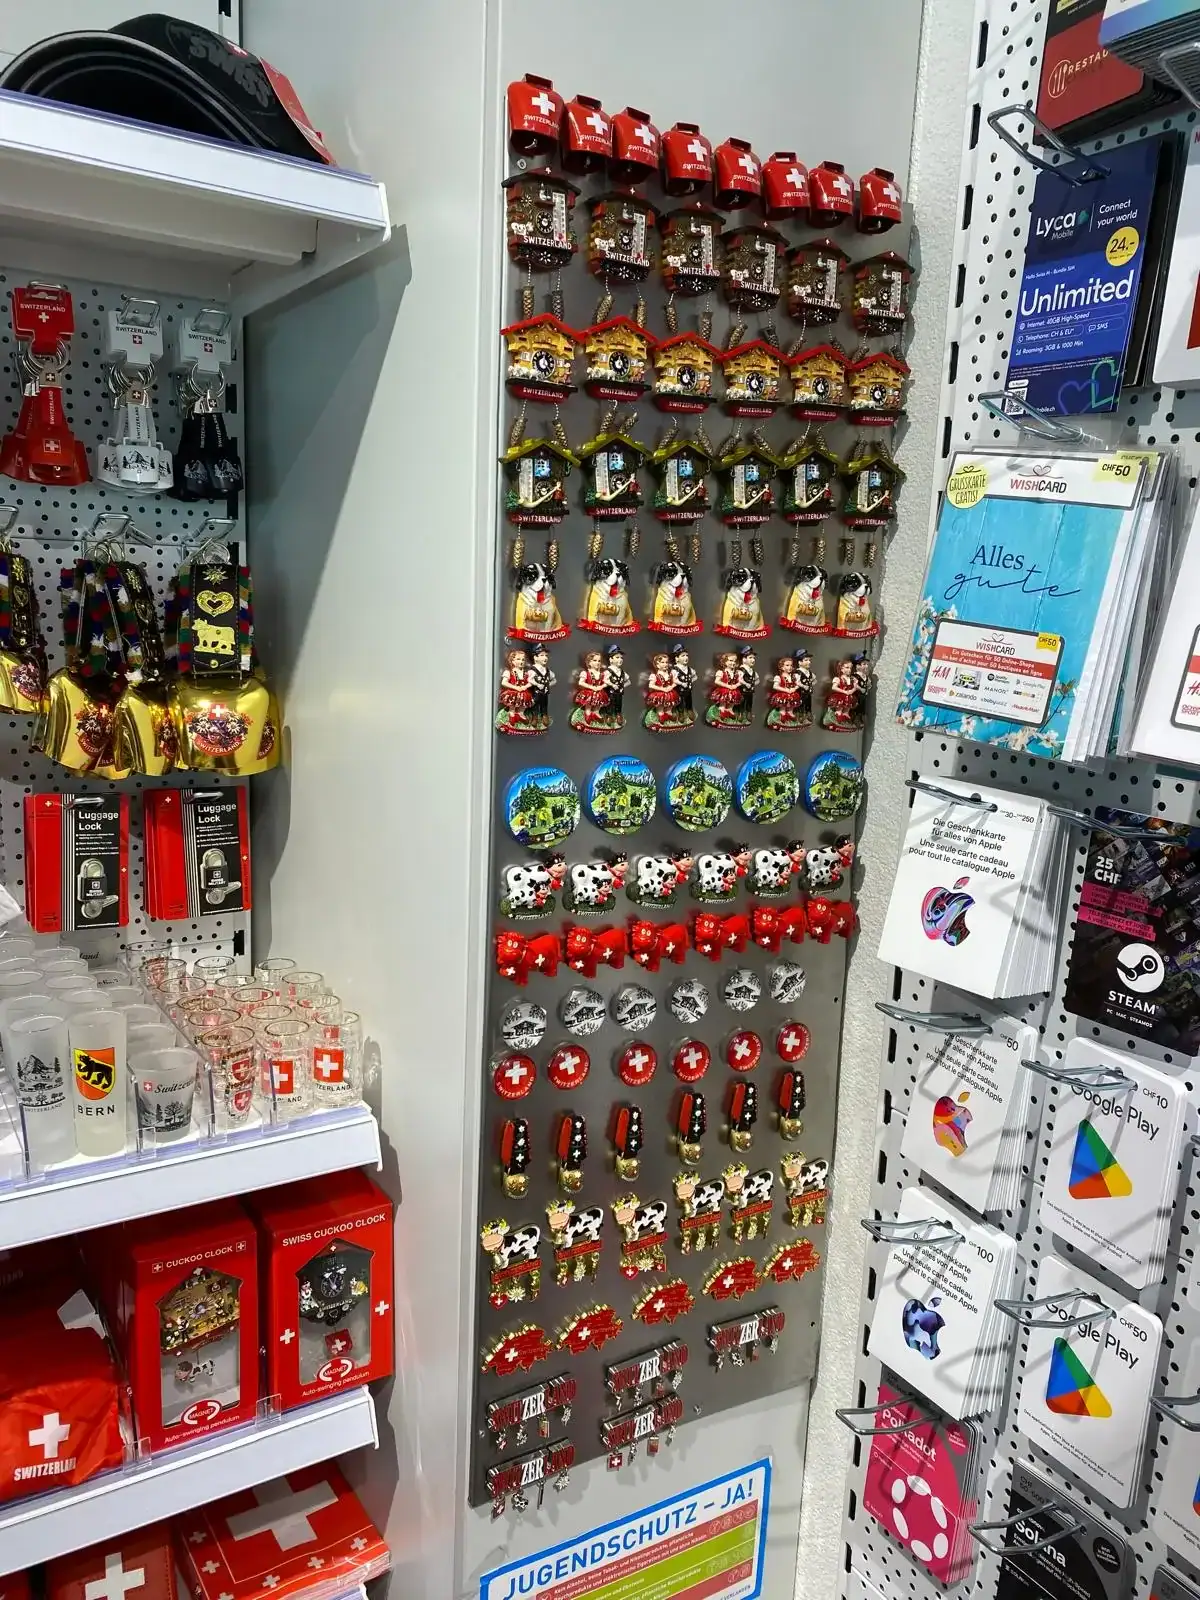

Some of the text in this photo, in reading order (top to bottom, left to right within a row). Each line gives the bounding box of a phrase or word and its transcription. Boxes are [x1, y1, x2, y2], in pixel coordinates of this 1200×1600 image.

[1099, 199, 1132, 214] Connect
[1035, 211, 1077, 237] Lyca
[1097, 209, 1139, 229] your world
[523, 235, 572, 250] SWITZERLAND
[1052, 229, 1074, 240] Mobile
[1109, 237, 1135, 254] 24.-
[605, 250, 650, 267] SWITZERLAND
[678, 266, 720, 278] SWITZERLAND
[740, 281, 780, 295] SWITZERLAND
[1020, 270, 1135, 317] Unlimited
[20, 302, 66, 313] SWITZERLAND
[803, 296, 842, 310] SWITZERLAND
[868, 308, 906, 320] SWITZERLAND
[1061, 312, 1091, 323] High-Speed
[115, 326, 158, 336] SWITZERLAND
[1096, 322, 1109, 330] SMS
[188, 334, 226, 345] SWITZERLAND
[1061, 341, 1074, 349] 1000
[523, 387, 564, 399] SWITZERLAND
[949, 474, 986, 491] GRUSSKARTE
[1010, 478, 1068, 494] WISHCARD
[955, 489, 979, 505] GRATIS!
[518, 514, 562, 524] SWITZERLAND
[596, 507, 637, 515] SWITZERLAND
[667, 512, 704, 520] SWITZERLAND
[795, 512, 830, 520] SWITZERLAND
[855, 518, 887, 526] SWITZERLAND
[969, 544, 1025, 570] Alles
[944, 564, 1081, 600] gute
[524, 630, 566, 641] SWITZERLAND
[594, 624, 636, 635] SWITZERLAND
[661, 625, 700, 635] SWITZERLAND
[729, 628, 767, 639] SWITZERLAND
[794, 622, 829, 634] SWITZERLAND
[846, 627, 877, 639] SWITZERLAND
[975, 641, 1016, 656] WISHCARD
[960, 650, 984, 659] Gutschein
[1001, 657, 1035, 669] Online-Shops
[932, 666, 952, 680] H&M
[998, 663, 1022, 673] boutiques
[1030, 668, 1043, 677] ligne
[956, 692, 978, 701] zalando
[984, 686, 1007, 694] MANOR
[78, 810, 119, 821] Luggage
[197, 803, 237, 813] Luggage
[78, 822, 102, 831] Lock
[198, 814, 221, 824] Lock
[932, 817, 1006, 842] Die Geschenkkarte
[931, 827, 1002, 852] für alles von Apple
[919, 838, 1009, 868] Une seule carte cadeau
[908, 846, 1016, 880] pour tout le catalogue Apple
[1095, 856, 1114, 870] 25
[1094, 868, 1121, 885] CHF
[1108, 990, 1156, 1015] STEAM
[1116, 1011, 1127, 1019] MAC
[1129, 1016, 1153, 1028] STEAMOS
[954, 1034, 998, 1065] Geschenkkarte
[952, 1044, 995, 1074] alles von Apple
[553, 1061, 589, 1088] SWITZERLAND
[621, 1061, 656, 1086] SWITZERLAND
[934, 1046, 999, 1091] Une seule carte cadeau
[496, 1075, 535, 1098] SWITZERLAND
[950, 1065, 957, 1075] le
[957, 1071, 985, 1094] catalogue
[984, 1088, 1003, 1104] Apple
[1142, 1088, 1168, 1109] CHF10
[25, 1103, 63, 1113] SWITZERLAND
[77, 1104, 115, 1116] BERN
[1071, 1085, 1160, 1141] Google Play
[282, 1213, 386, 1247] SWISS CUCKOO CLOCK
[166, 1245, 233, 1269] CUCKOO CLOCK
[902, 1248, 973, 1300] Une seule carte cadeau
[921, 1249, 968, 1283] alles von Apple
[893, 1253, 978, 1314] pour tout le catalogue Apple
[715, 1312, 786, 1351] SWITZERLAND
[1119, 1317, 1148, 1342] CHF50
[1104, 1334, 1139, 1370] Play
[323, 1365, 348, 1377] MAGNET
[613, 1345, 689, 1392] SWITZERLAND
[302, 1371, 370, 1397] Auto-swinging pendulum
[188, 1405, 215, 1420] MAGNET
[493, 1379, 576, 1431] SWITZERLAND
[164, 1414, 240, 1444] Auto-swinging pendulum
[608, 1401, 683, 1448] SWITZERLAND
[493, 1446, 575, 1497] SWITZERLAND
[502, 1502, 697, 1600] JUGENDSCHUTZ
[720, 1477, 754, 1509] JA!
